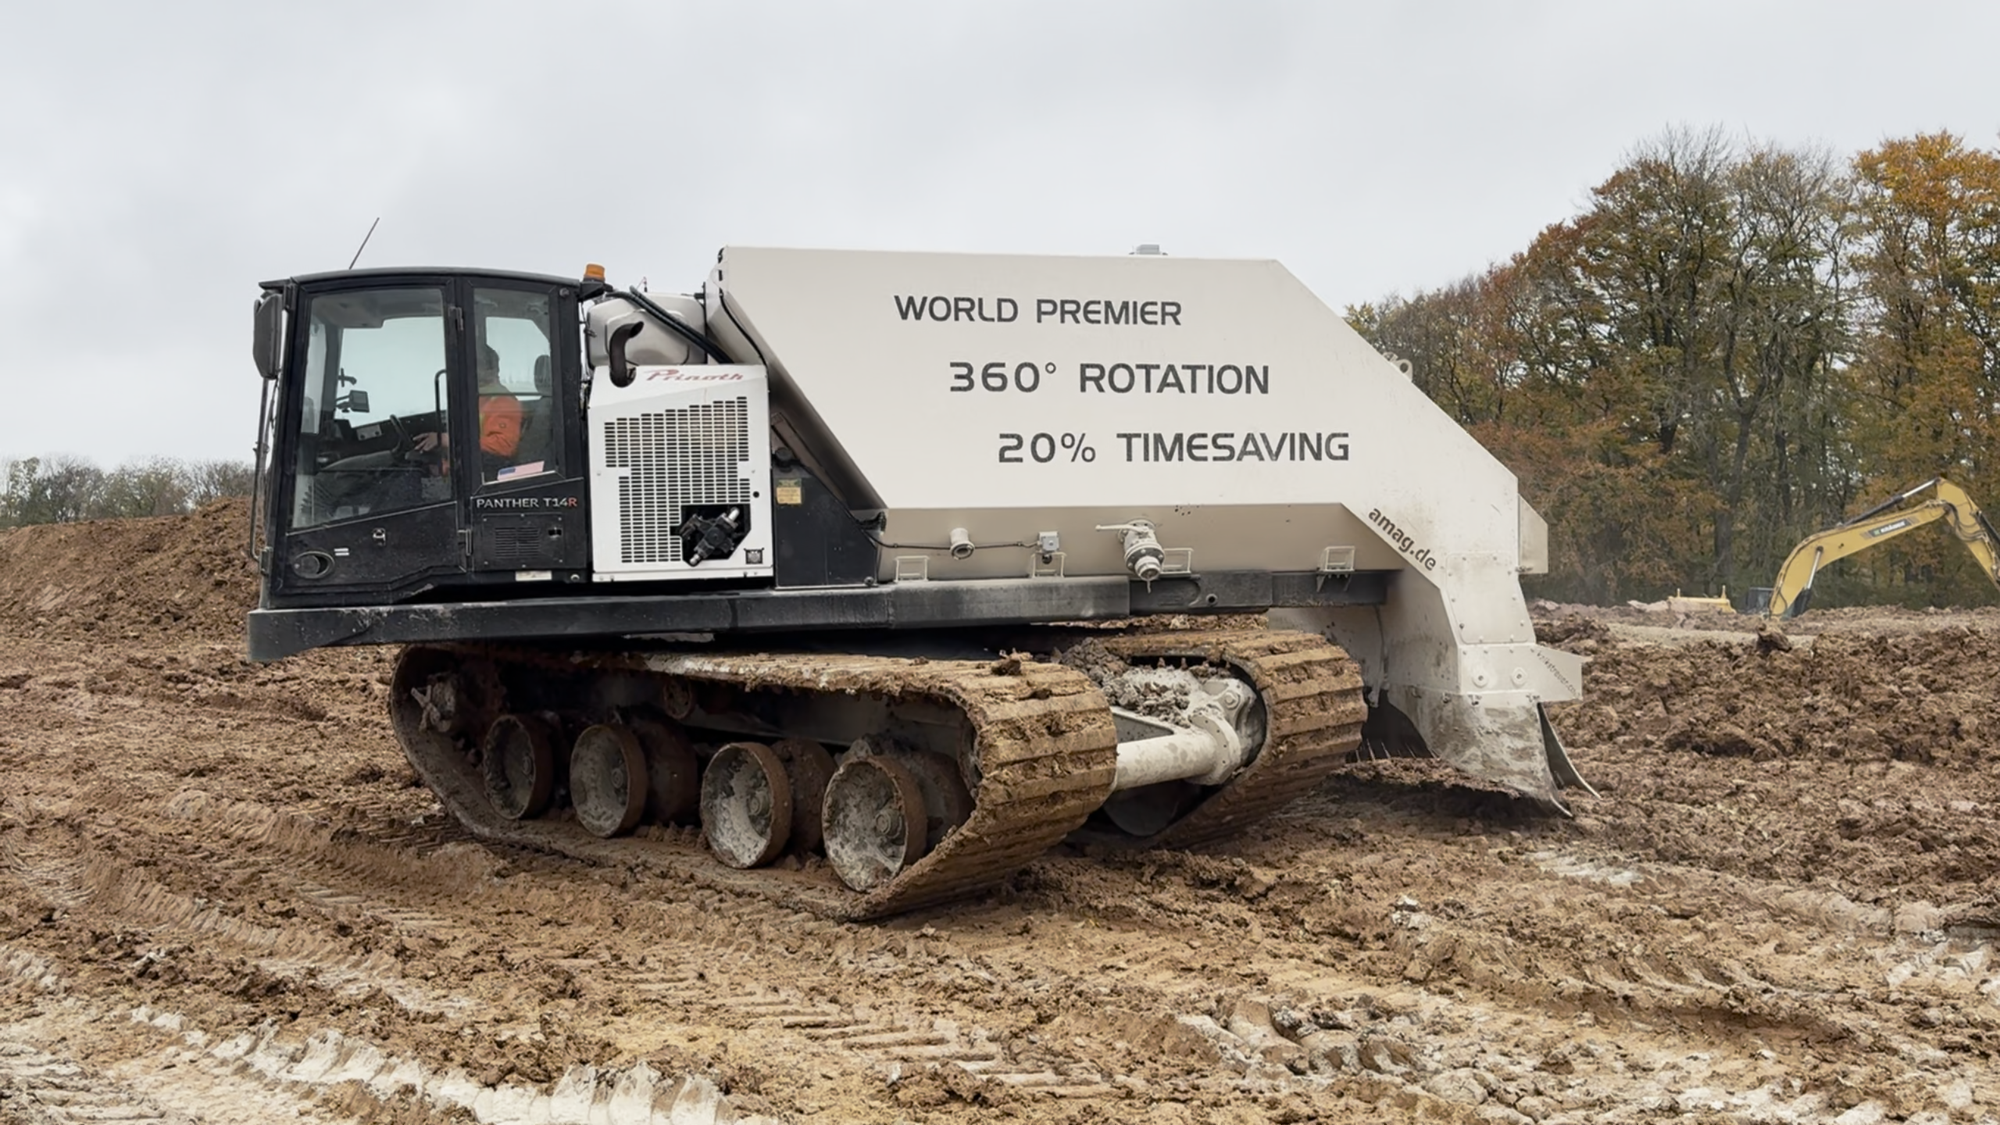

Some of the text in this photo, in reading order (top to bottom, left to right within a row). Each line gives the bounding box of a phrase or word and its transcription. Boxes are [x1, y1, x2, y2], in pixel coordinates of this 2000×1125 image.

[894, 296, 1181, 325] WORLD PREMIER
[646, 369, 744, 381] Prinoth
[950, 362, 1268, 394] 360° ROTATION
[999, 433, 1348, 463] 20% TIMESAVING
[476, 497, 577, 509] PANTHER T14R
[1368, 508, 1437, 571] amag.de
